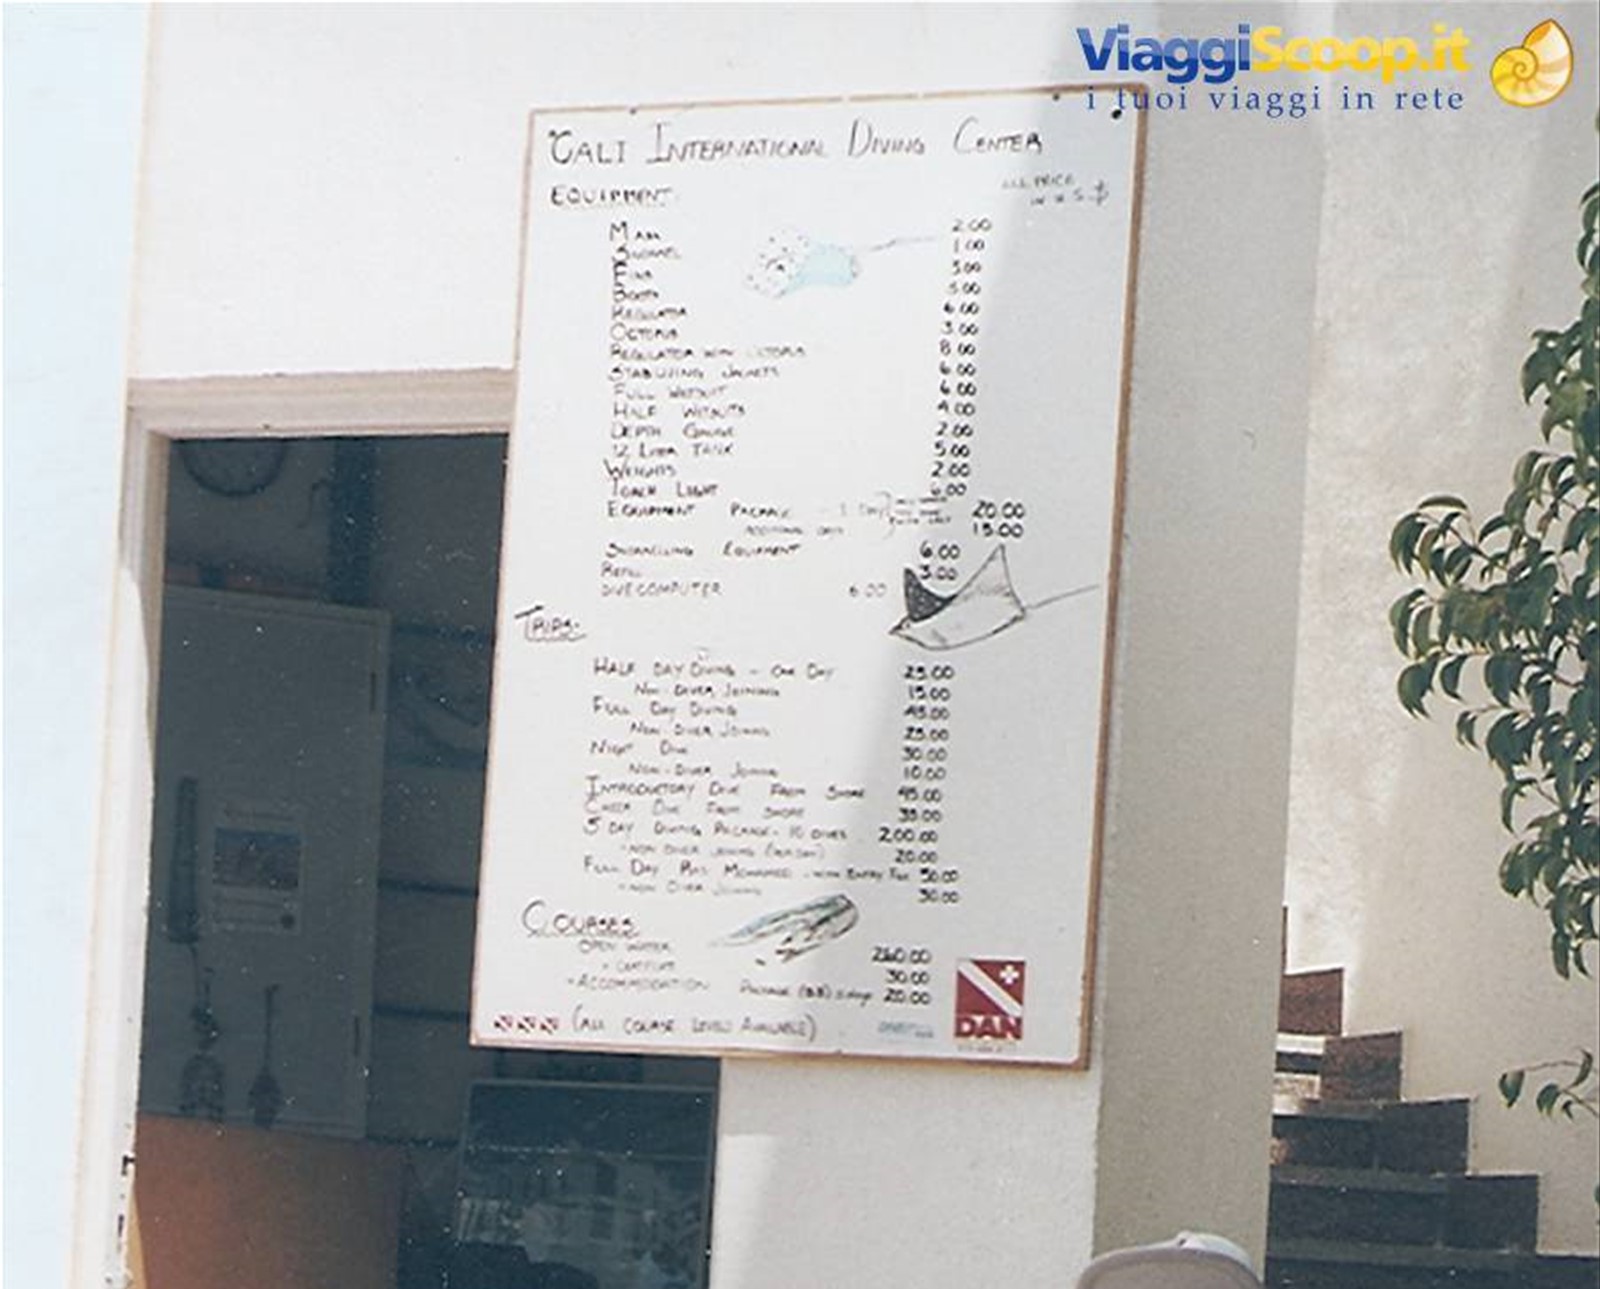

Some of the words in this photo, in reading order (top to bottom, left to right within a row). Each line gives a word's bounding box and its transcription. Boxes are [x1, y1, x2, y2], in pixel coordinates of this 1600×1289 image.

[848, 118, 925, 157] DIVING
[953, 116, 1042, 154] CENTER
[550, 185, 673, 207] EQUIPMENT
[954, 1016, 1023, 1040] DAN
